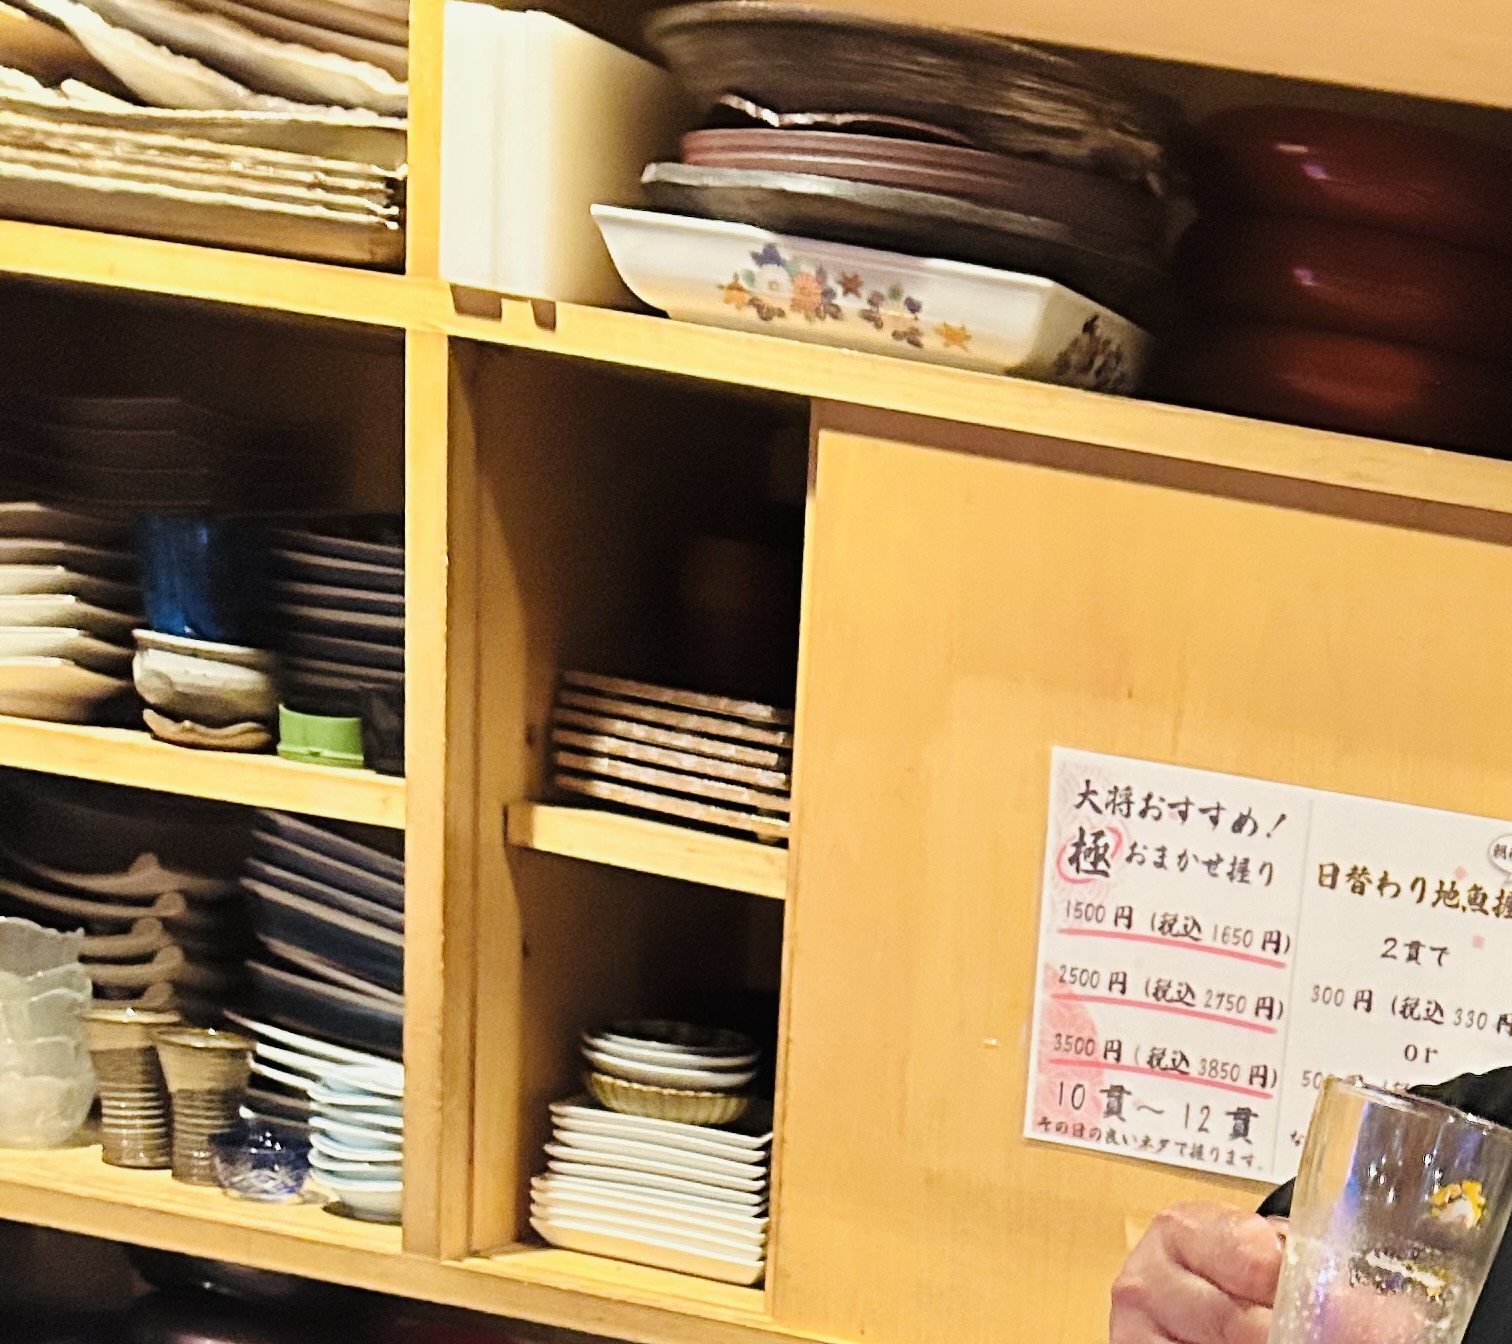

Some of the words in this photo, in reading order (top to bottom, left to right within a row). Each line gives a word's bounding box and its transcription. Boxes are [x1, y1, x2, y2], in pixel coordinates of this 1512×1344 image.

[1068, 826, 1111, 878] 極
[1125, 841, 1274, 887] おまかせ握り
[1404, 1044, 1438, 1063] or
